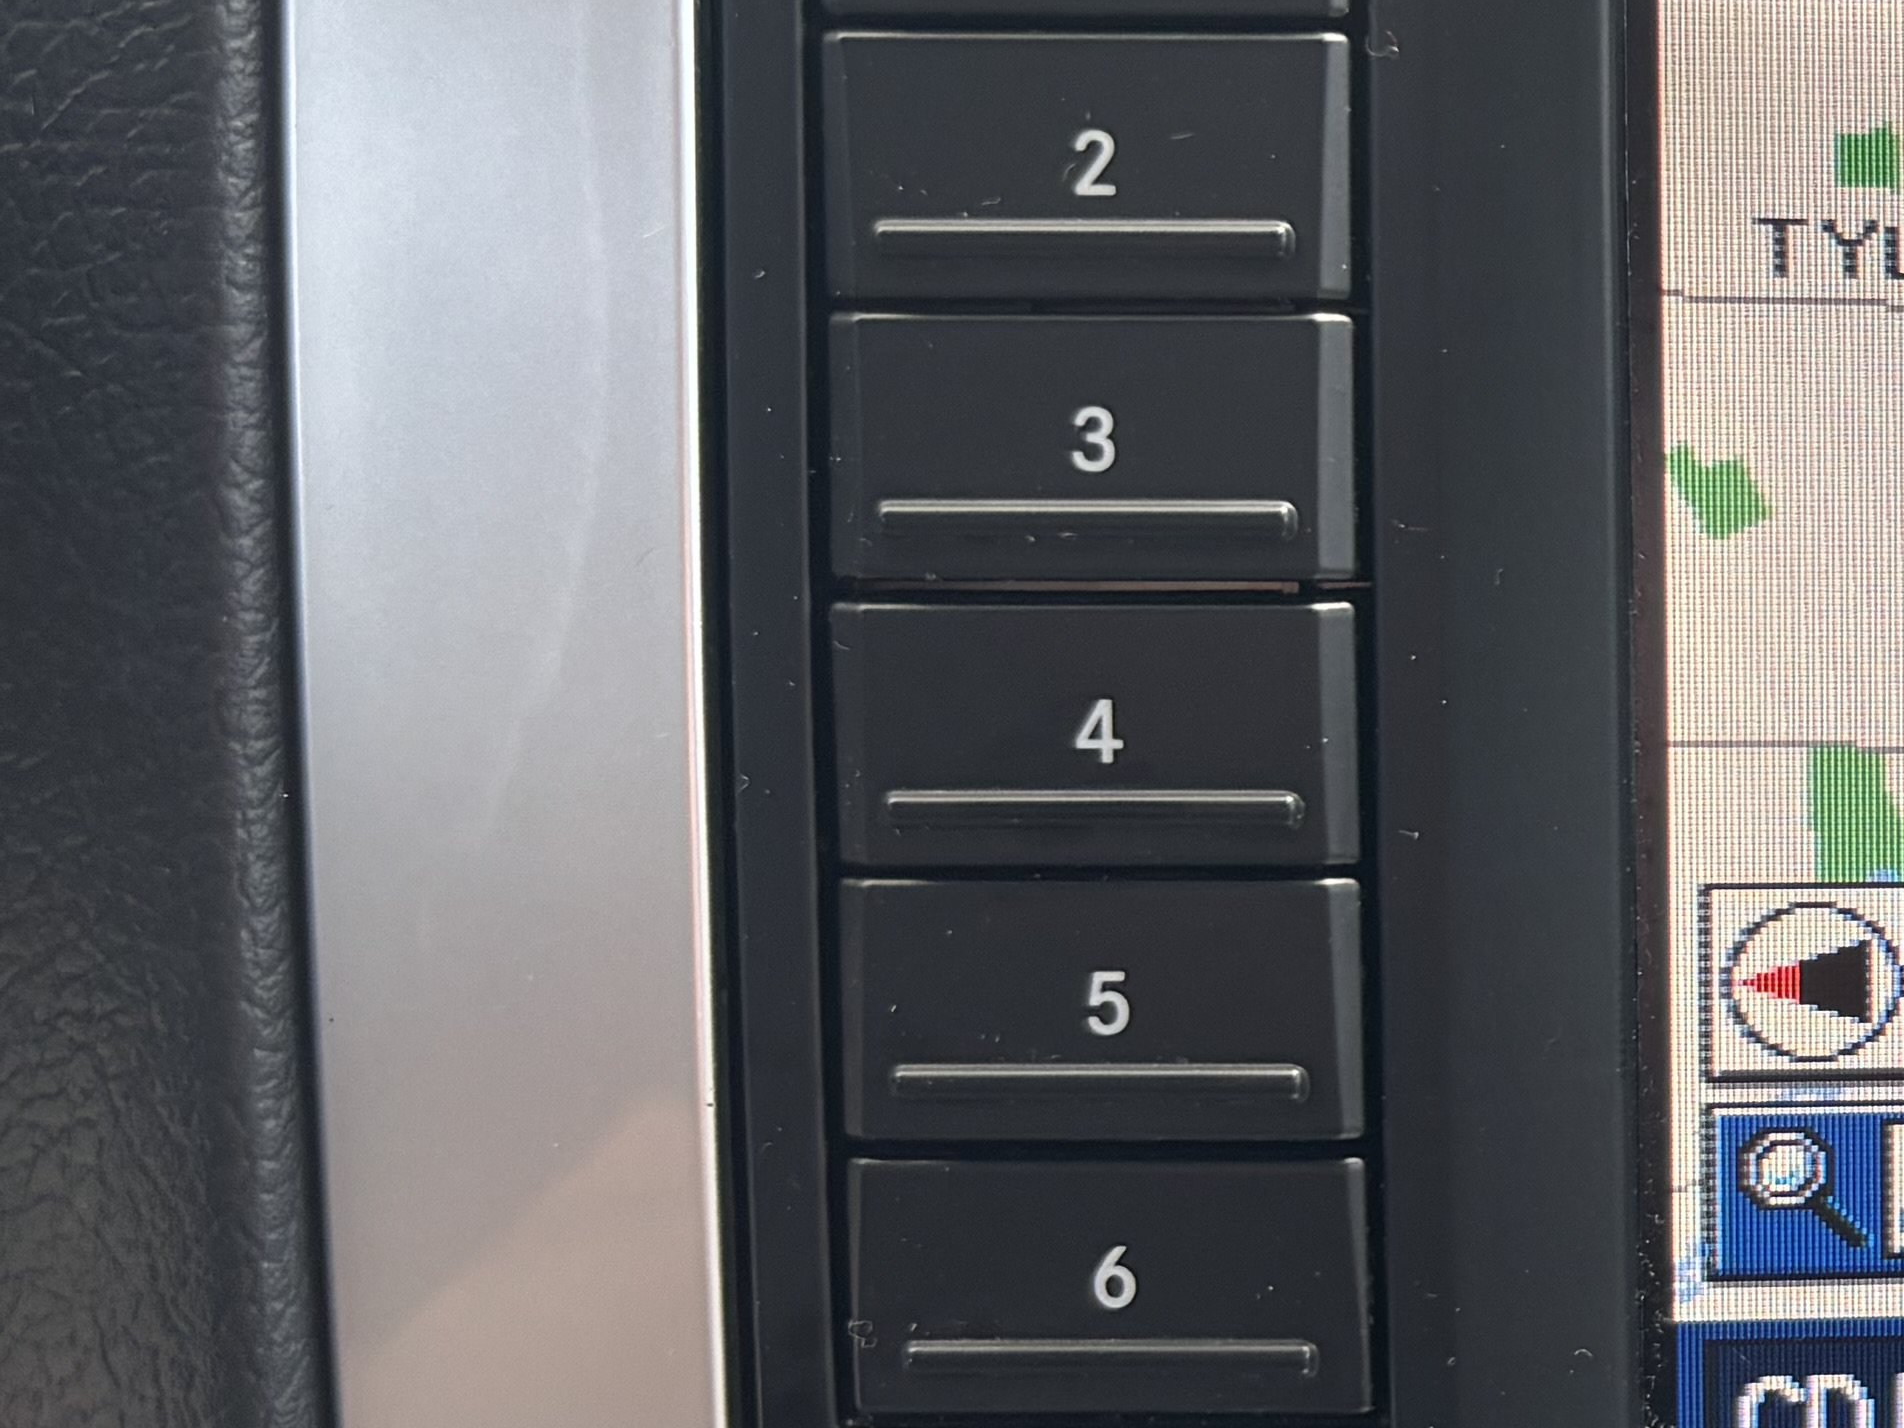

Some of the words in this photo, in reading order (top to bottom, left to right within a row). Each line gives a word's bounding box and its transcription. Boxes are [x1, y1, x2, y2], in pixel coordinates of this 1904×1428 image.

[1074, 129, 1117, 197] 2
[1072, 407, 1116, 472] 3
[1074, 698, 1123, 765] 4
[1085, 971, 1130, 1036] 5
[1092, 1245, 1137, 1309] 6
